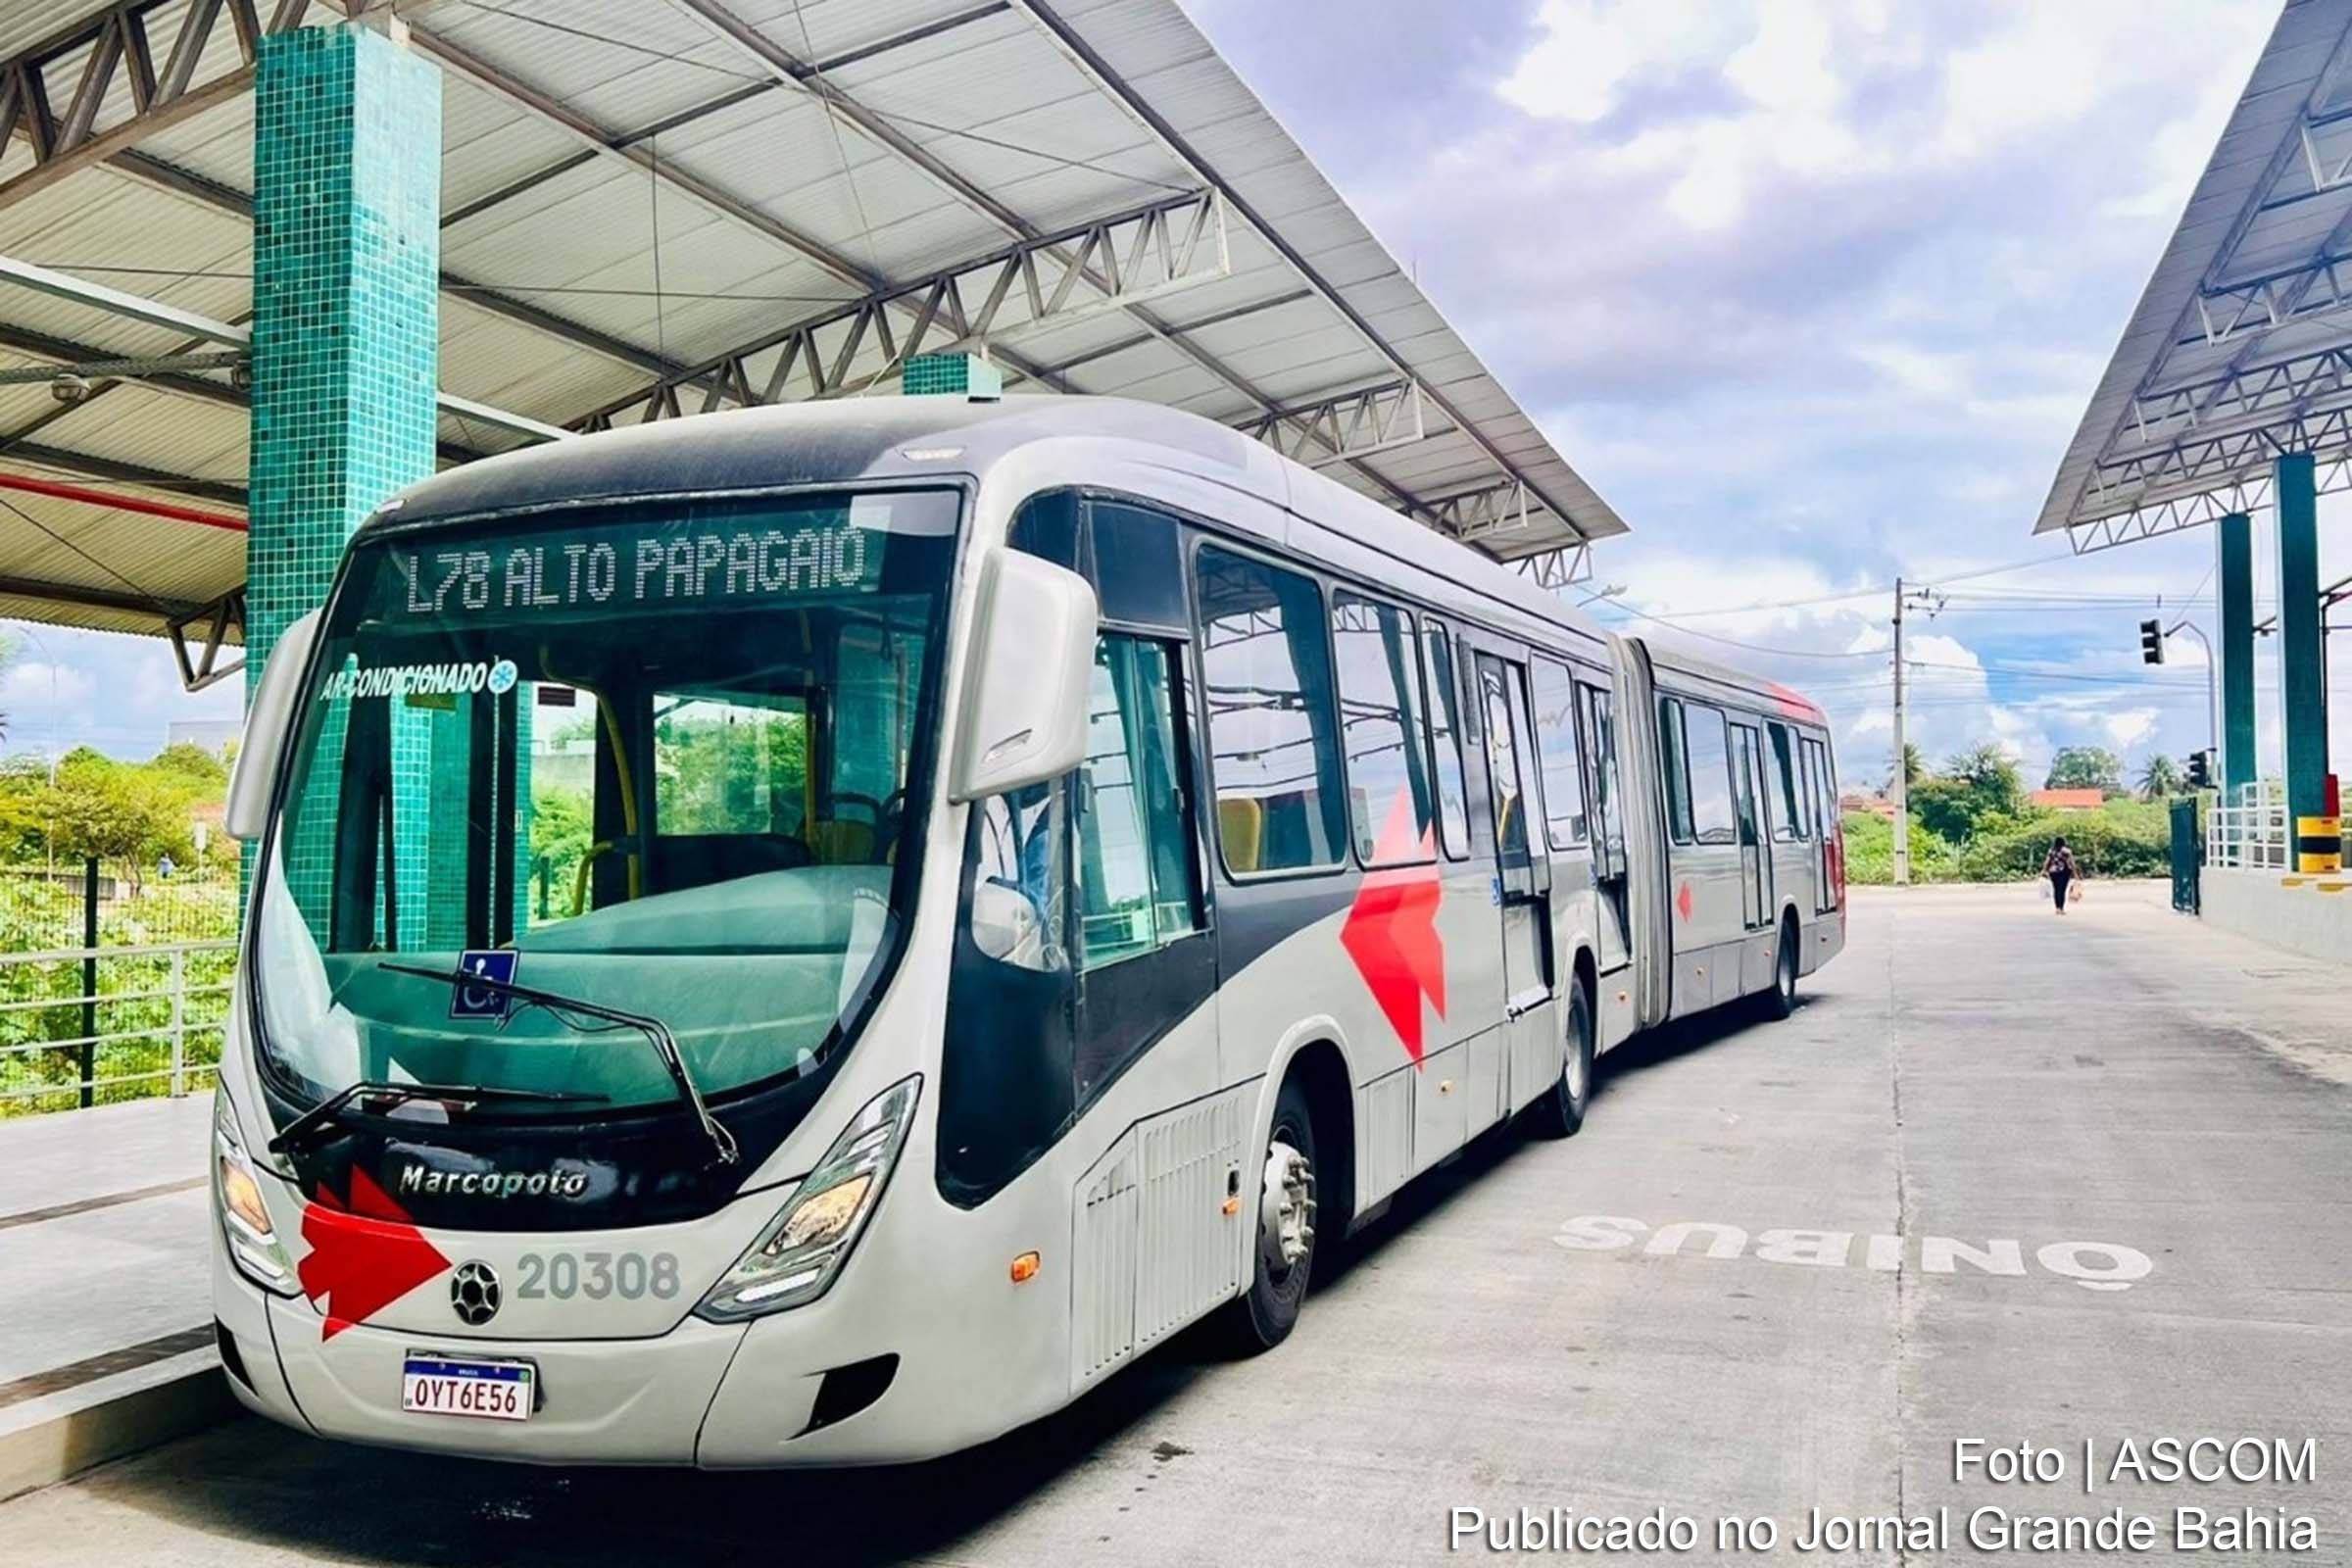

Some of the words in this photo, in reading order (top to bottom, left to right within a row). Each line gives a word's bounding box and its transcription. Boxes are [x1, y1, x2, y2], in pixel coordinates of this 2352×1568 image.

[408, 552, 491, 612] L78
[504, 542, 615, 607] ALTO
[635, 525, 864, 599] PAPAGAIO
[399, 1165, 588, 1200] Marcopolo
[516, 1251, 680, 1300] 20308
